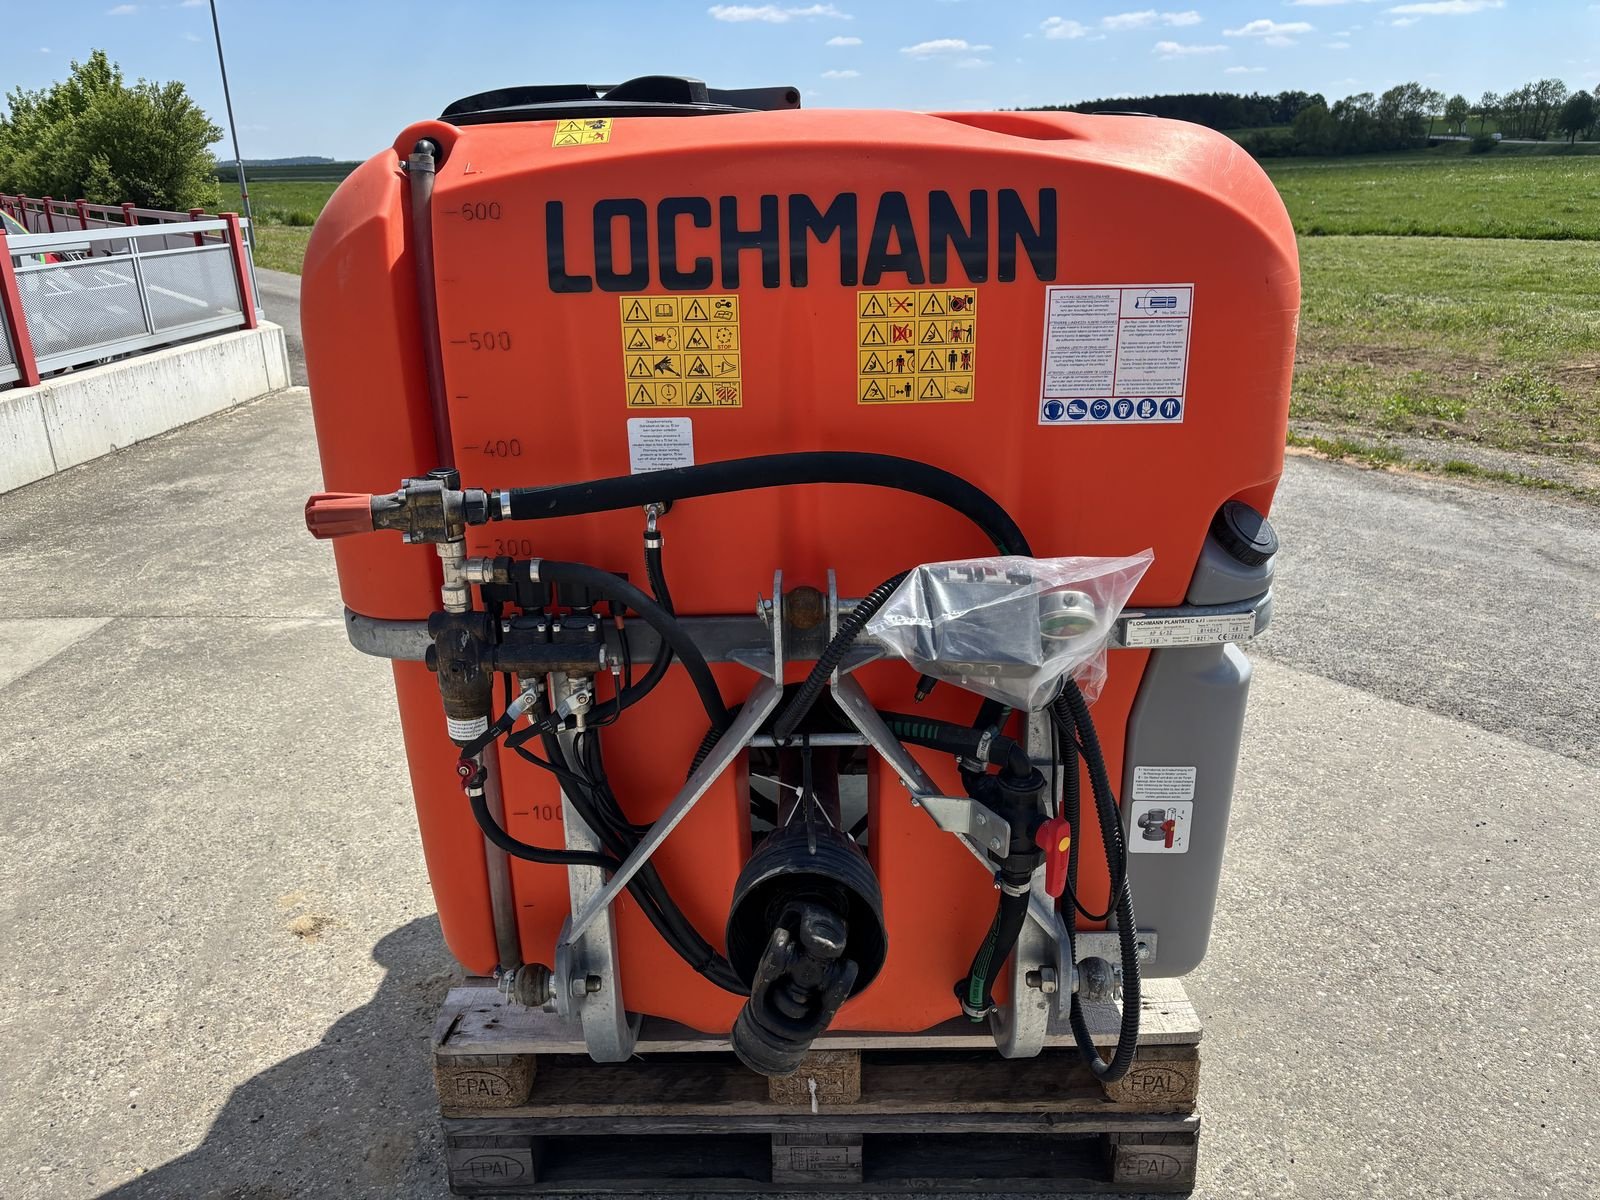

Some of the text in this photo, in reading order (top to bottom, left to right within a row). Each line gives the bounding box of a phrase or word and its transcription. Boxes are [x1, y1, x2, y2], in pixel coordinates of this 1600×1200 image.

[462, 202, 501, 221] 600
[545, 187, 1057, 294] LOCHMANN
[469, 331, 511, 351] 500
[483, 438, 521, 458] 400
[494, 538, 532, 557] 300
[1133, 619, 1164, 627] LOCHMANN
[1164, 617, 1195, 625] PLANTATEC
[456, 1077, 502, 1096] EPAL
[1131, 1074, 1178, 1093] EPAL
